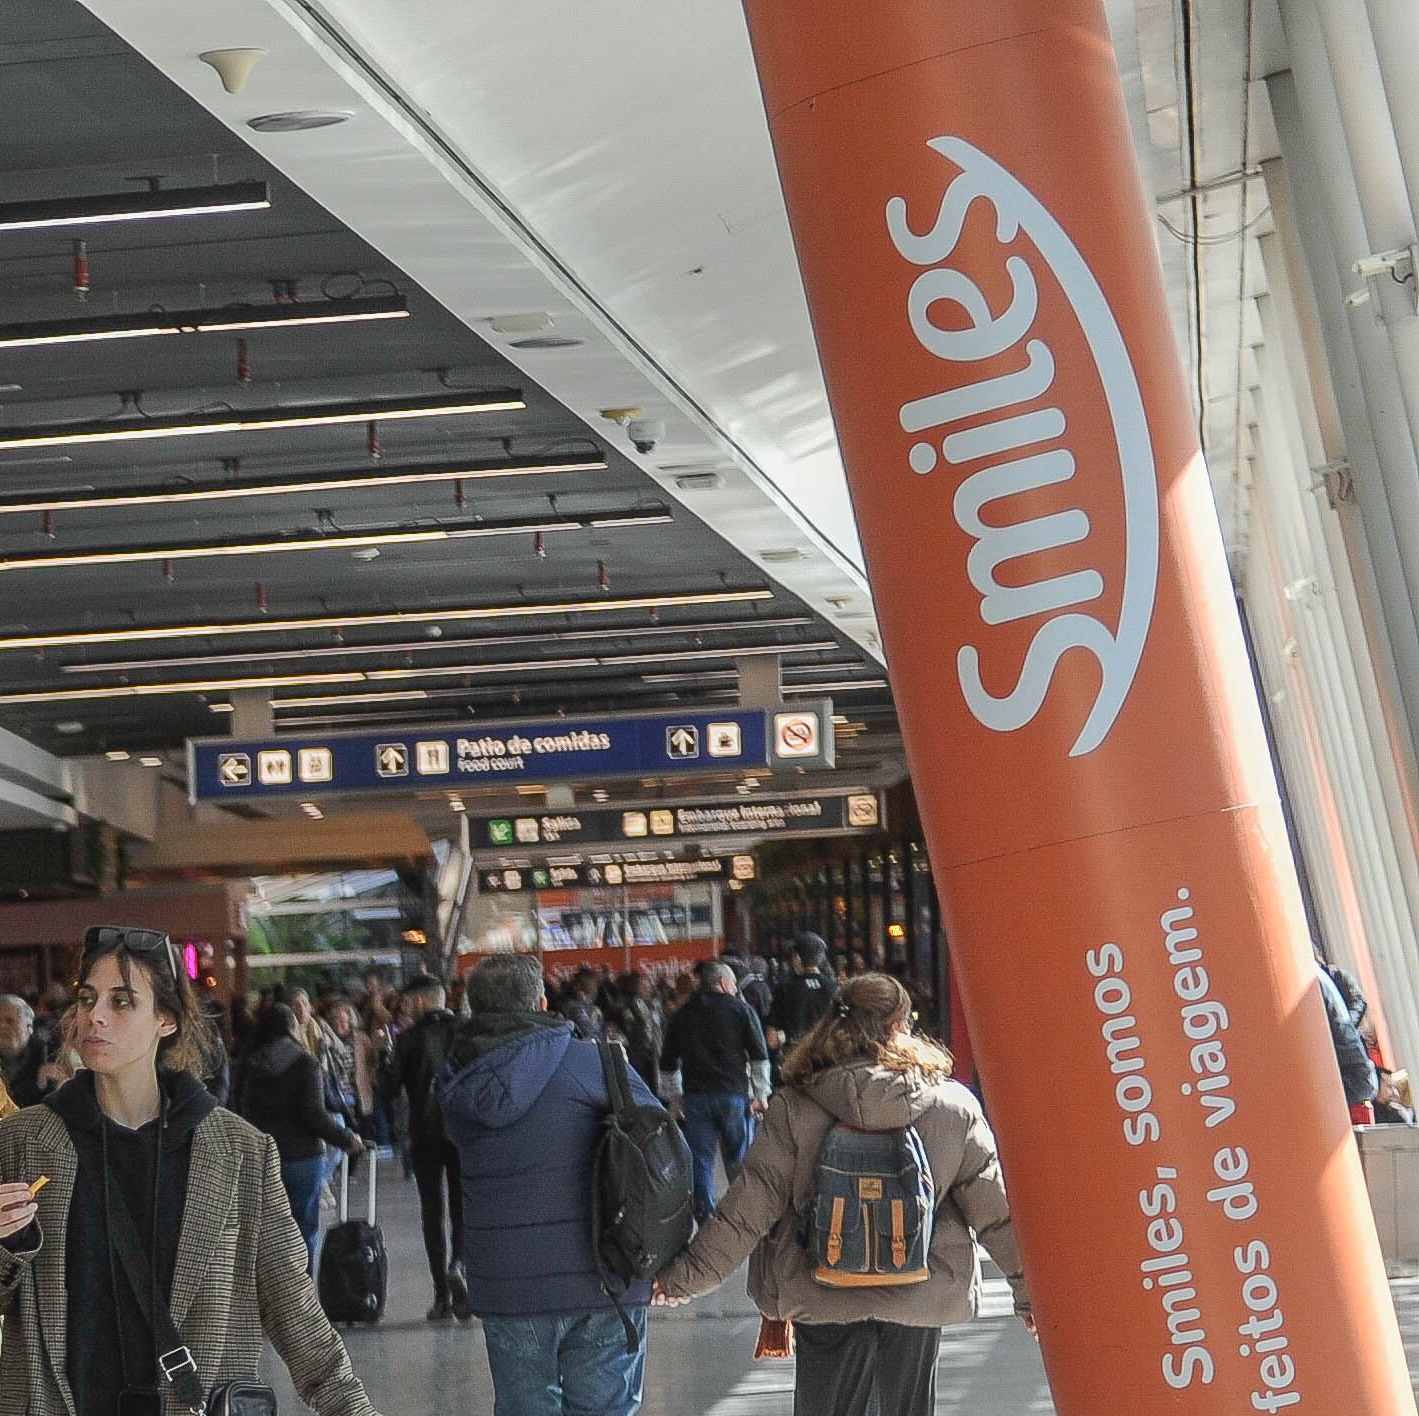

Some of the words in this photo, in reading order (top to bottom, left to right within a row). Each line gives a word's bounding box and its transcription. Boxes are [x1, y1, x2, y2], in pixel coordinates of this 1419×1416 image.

[886, 136, 1160, 758] Smiles
[456, 736, 506, 758] Patio
[507, 734, 533, 755] de
[533, 730, 611, 753] comidas
[1086, 942, 1160, 1146] somos
[1161, 886, 1237, 1128] viagem.
[1139, 1164, 1214, 1389] Smiles,
[1206, 1144, 1260, 1221] de
[1234, 1238, 1301, 1414] feitos
